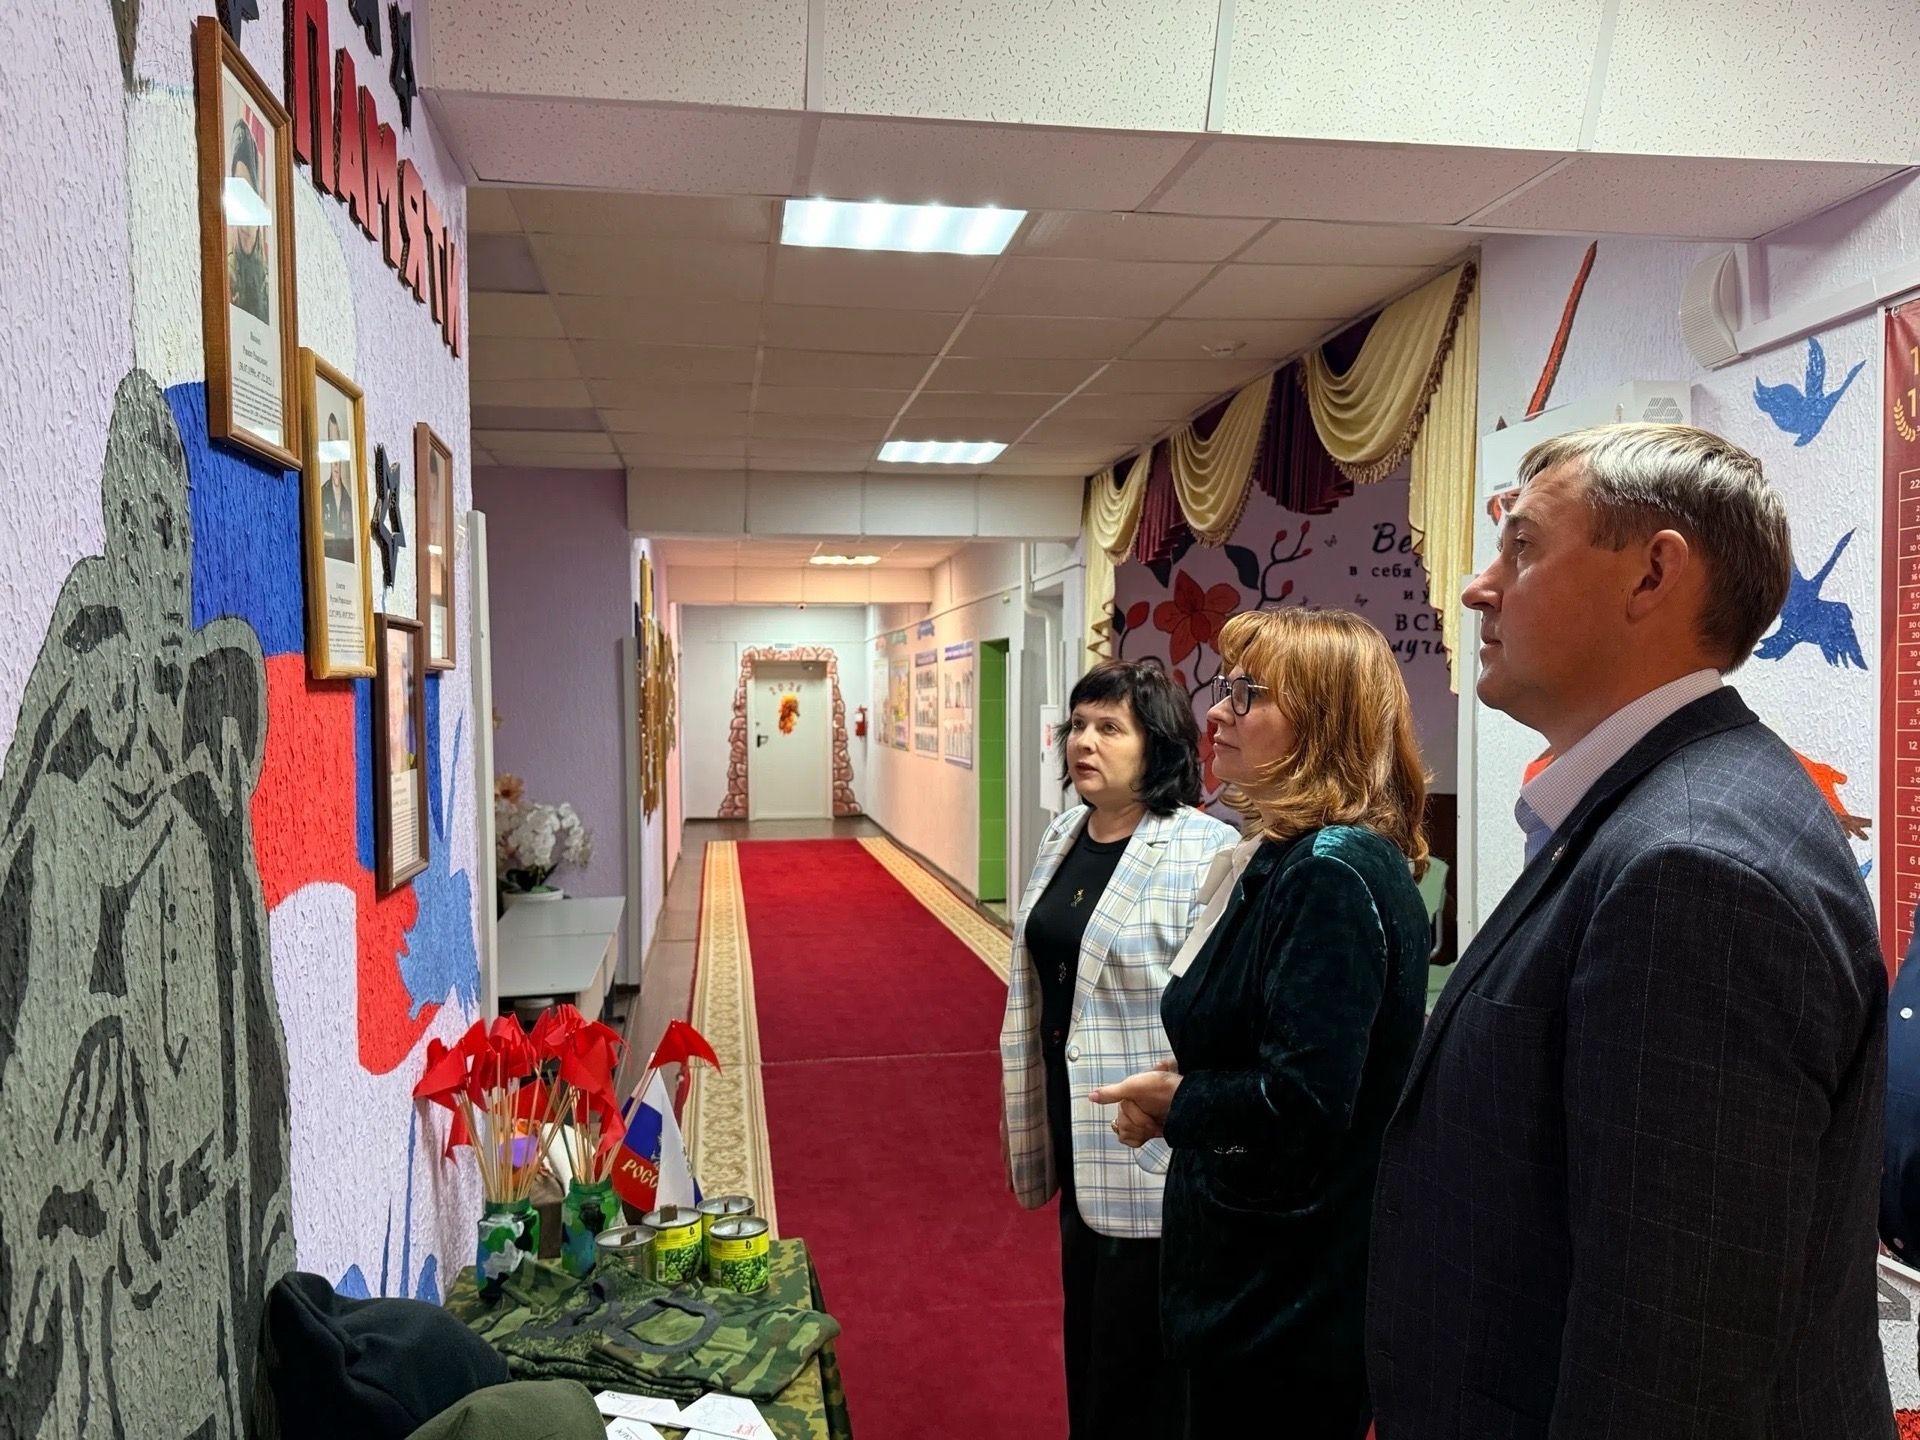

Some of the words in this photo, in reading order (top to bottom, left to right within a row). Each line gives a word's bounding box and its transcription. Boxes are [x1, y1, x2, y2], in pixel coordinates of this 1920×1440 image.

[284, 0, 461, 360] ПАМЯТИ
[1373, 522, 1412, 554] Ве
[1372, 564, 1412, 577] себя
[1404, 590, 1414, 600] и
[1908, 741, 1918, 750] 12
[1910, 856, 1916, 865] 6
[621, 1159, 659, 1188] РОСС
